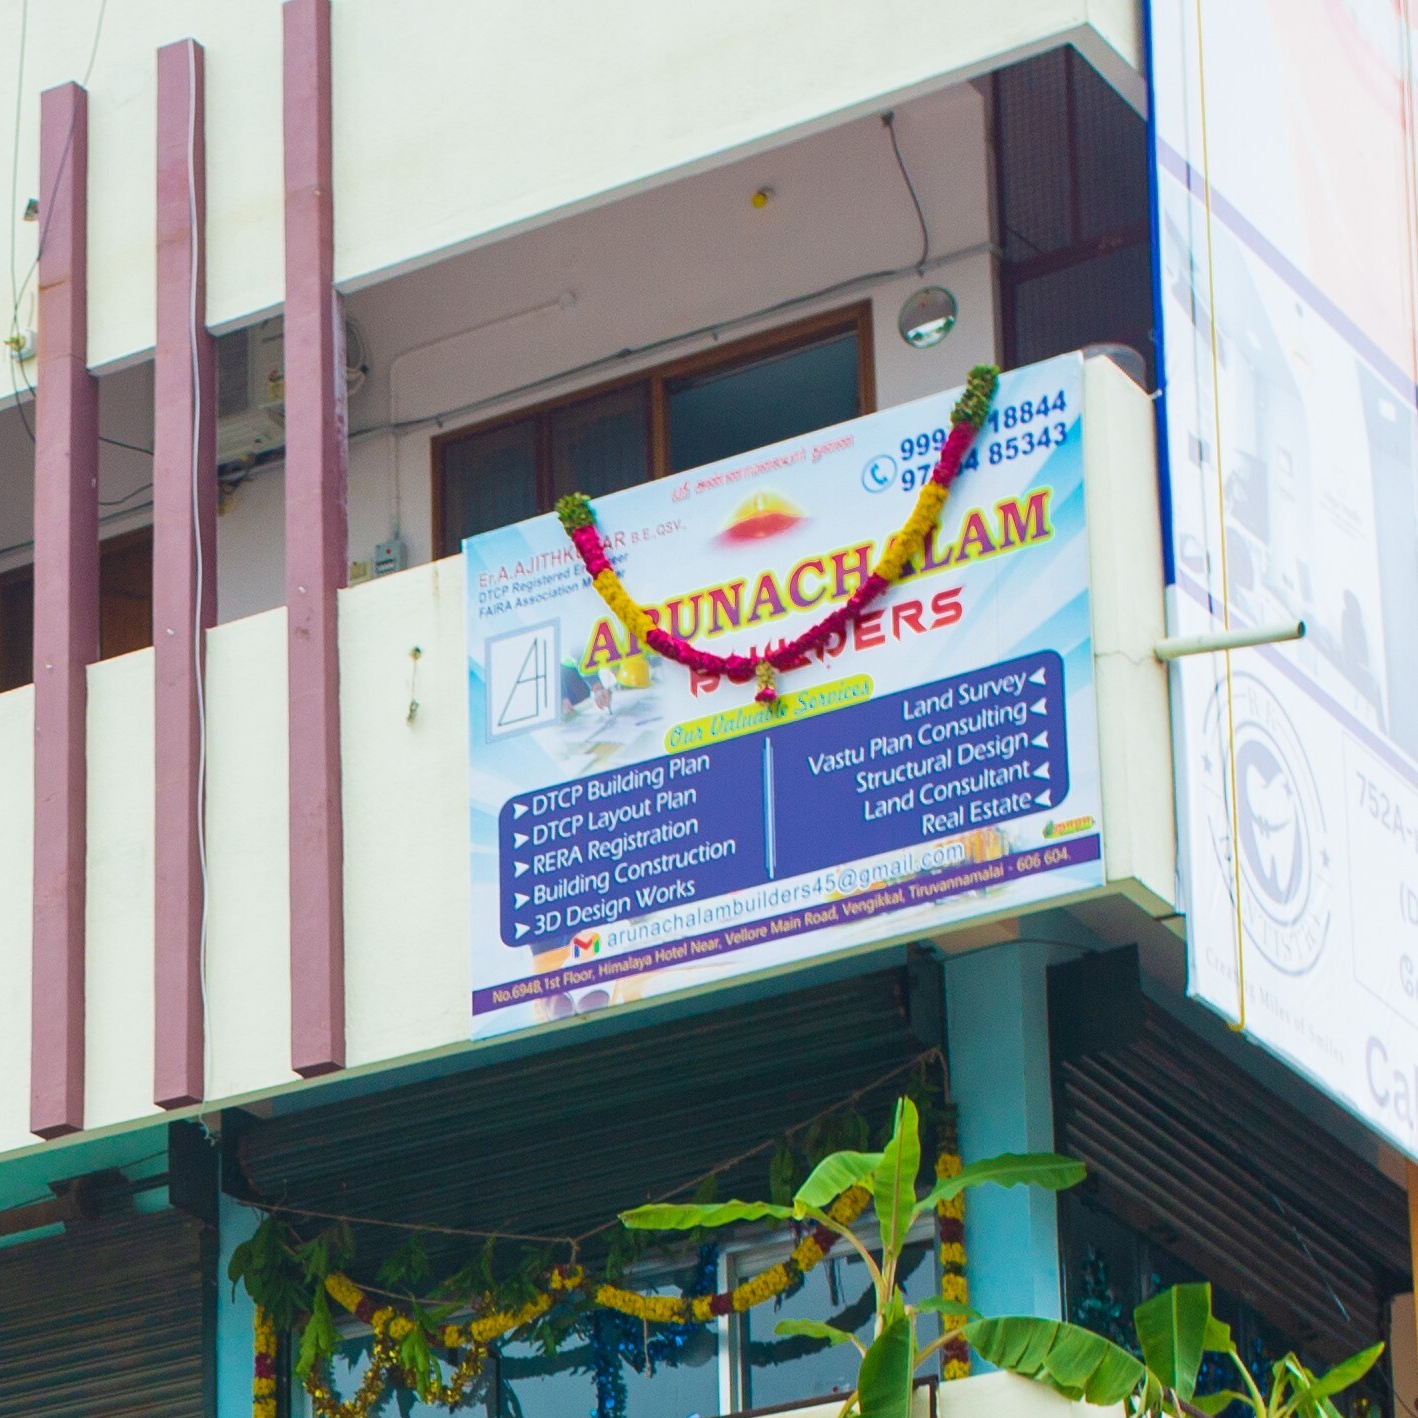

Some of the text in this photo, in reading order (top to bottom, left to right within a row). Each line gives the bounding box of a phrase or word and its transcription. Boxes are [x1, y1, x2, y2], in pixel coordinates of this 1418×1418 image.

[988, 389, 1067, 433] 18844
[988, 422, 1068, 466] 85343
[479, 570, 571, 604] DTCP Registered
[515, 582, 580, 609] Association
[903, 672, 1027, 721] Land Survey
[808, 701, 1028, 776] Vastu Plan Consulting
[856, 732, 1029, 794] Structural Design
[532, 754, 711, 816] DTCP Building Plan
[864, 760, 1031, 821] Land Consultant
[921, 791, 1033, 836] Real Estate
[533, 787, 697, 846] DTCP Layout Plan
[533, 818, 699, 876] RERA Registration
[534, 838, 737, 906] Building Construction
[534, 879, 696, 936] 3D Design Works
[598, 954, 653, 976] Himalaya
[655, 944, 689, 963] Hotel
[724, 925, 769, 946] Vellore
[770, 917, 803, 935] Main
[909, 865, 1004, 900] Tiruvannamalai
[1017, 855, 1042, 872] 606
[607, 842, 965, 948] arunachalambuilders45@gmail.com
